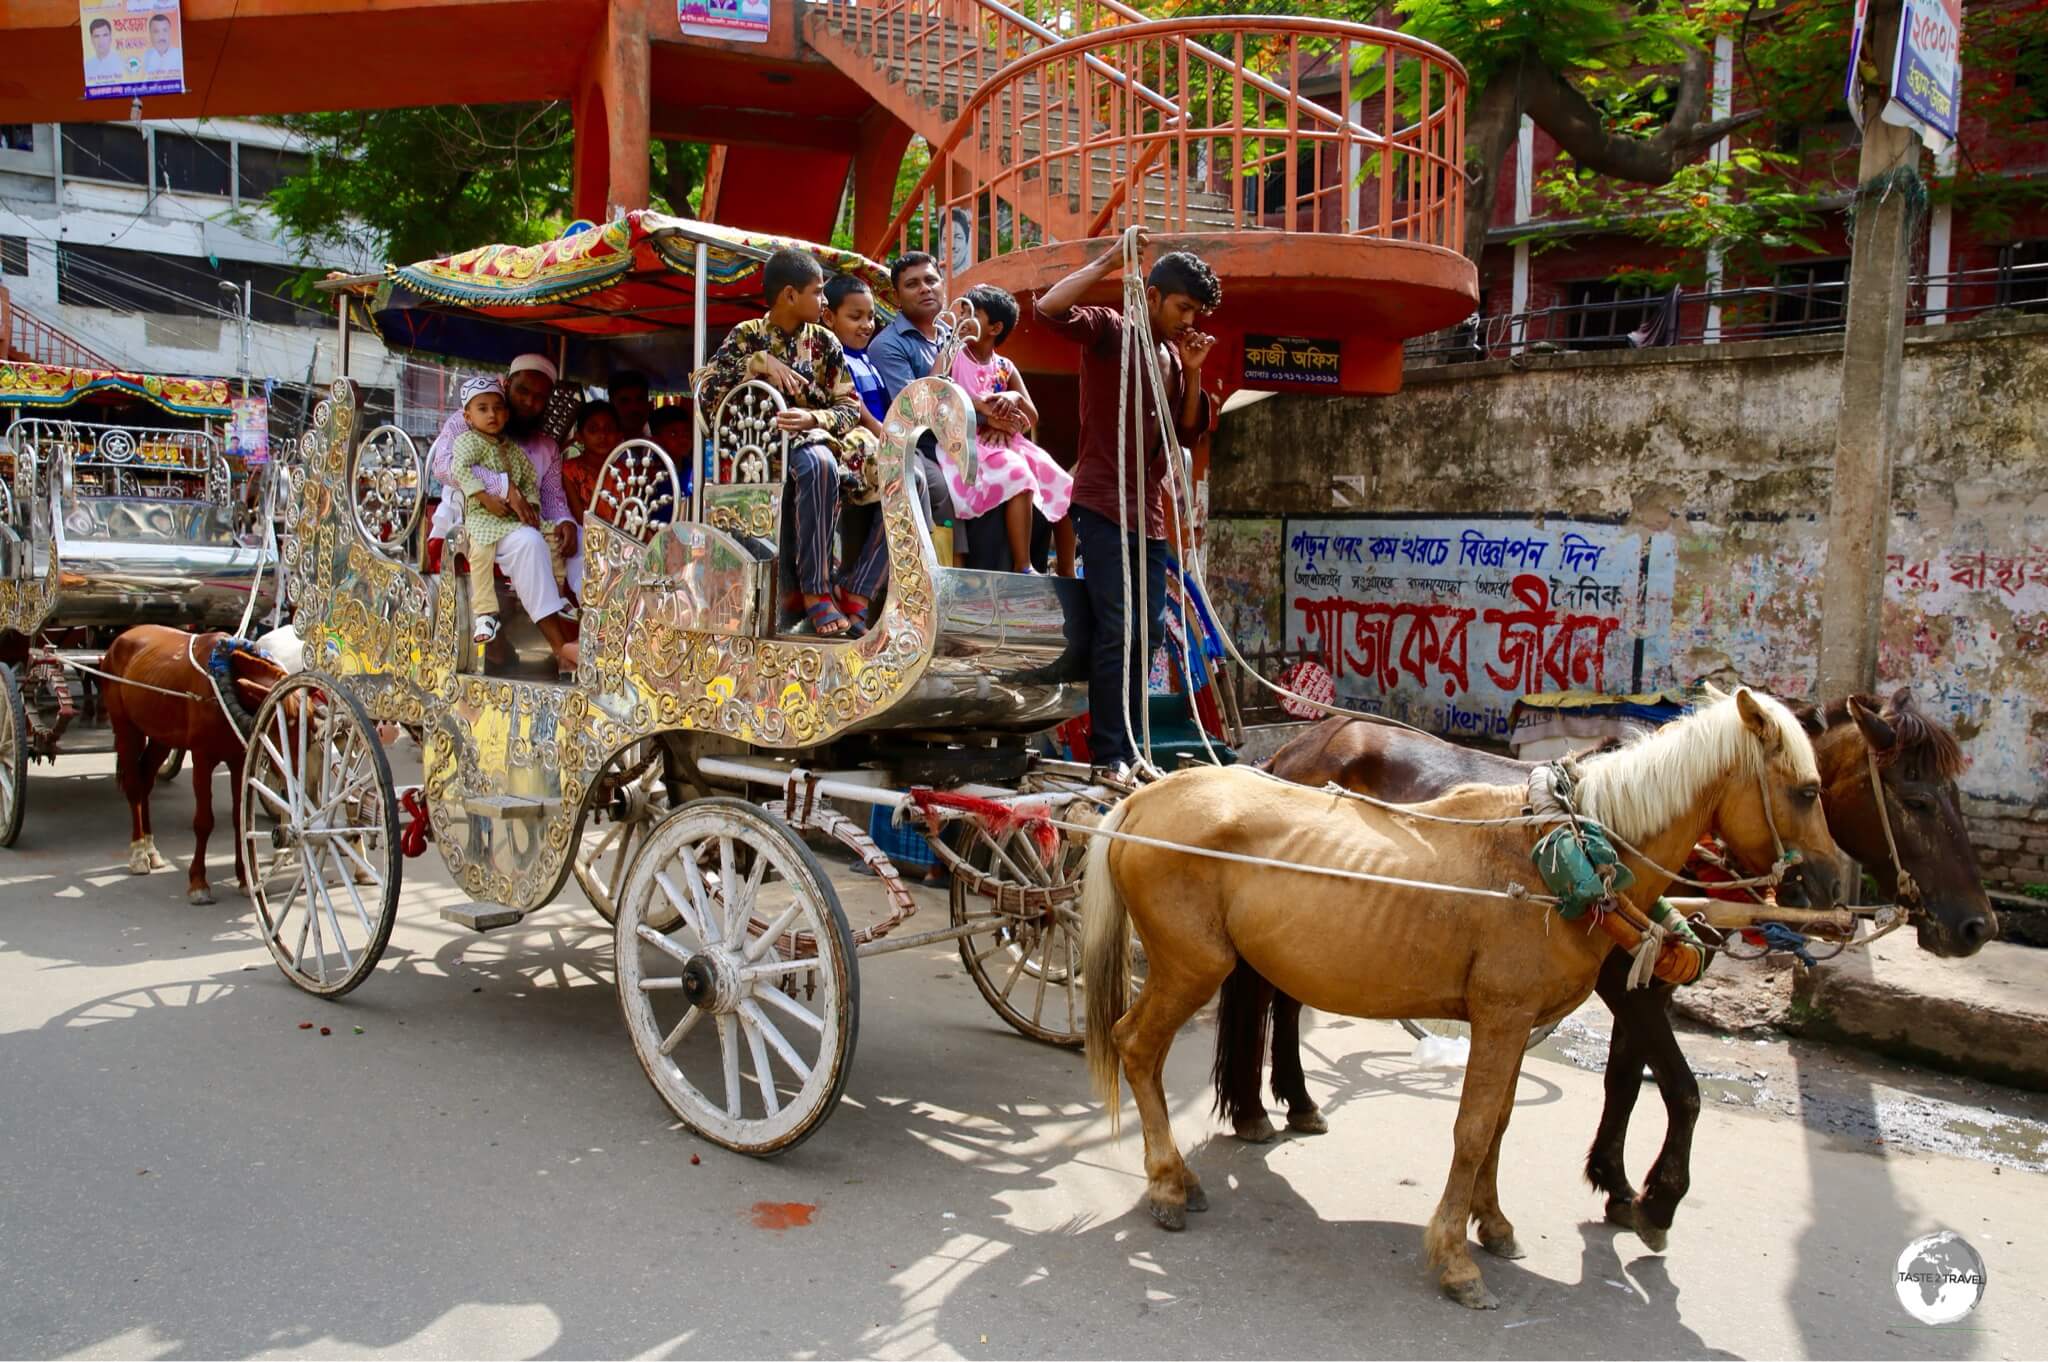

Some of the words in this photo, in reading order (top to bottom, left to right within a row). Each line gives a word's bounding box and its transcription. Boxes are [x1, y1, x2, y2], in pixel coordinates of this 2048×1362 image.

[1244, 344, 1287, 367] কাজী
[1291, 347, 1339, 370] অফিস
[1291, 530, 1330, 570] পড়ুন
[1333, 536, 1363, 564] এবং
[1368, 536, 1400, 563] কম
[1401, 535, 1449, 566] খরচে
[1460, 529, 1548, 569] বিজ্ঞাপন
[1559, 533, 1606, 572] দিন
[1474, 574, 1513, 599] আমরা
[1550, 575, 1622, 611] দৈনিক
[1294, 594, 1477, 697] আজকের
[1484, 573, 1620, 695] জীবন
